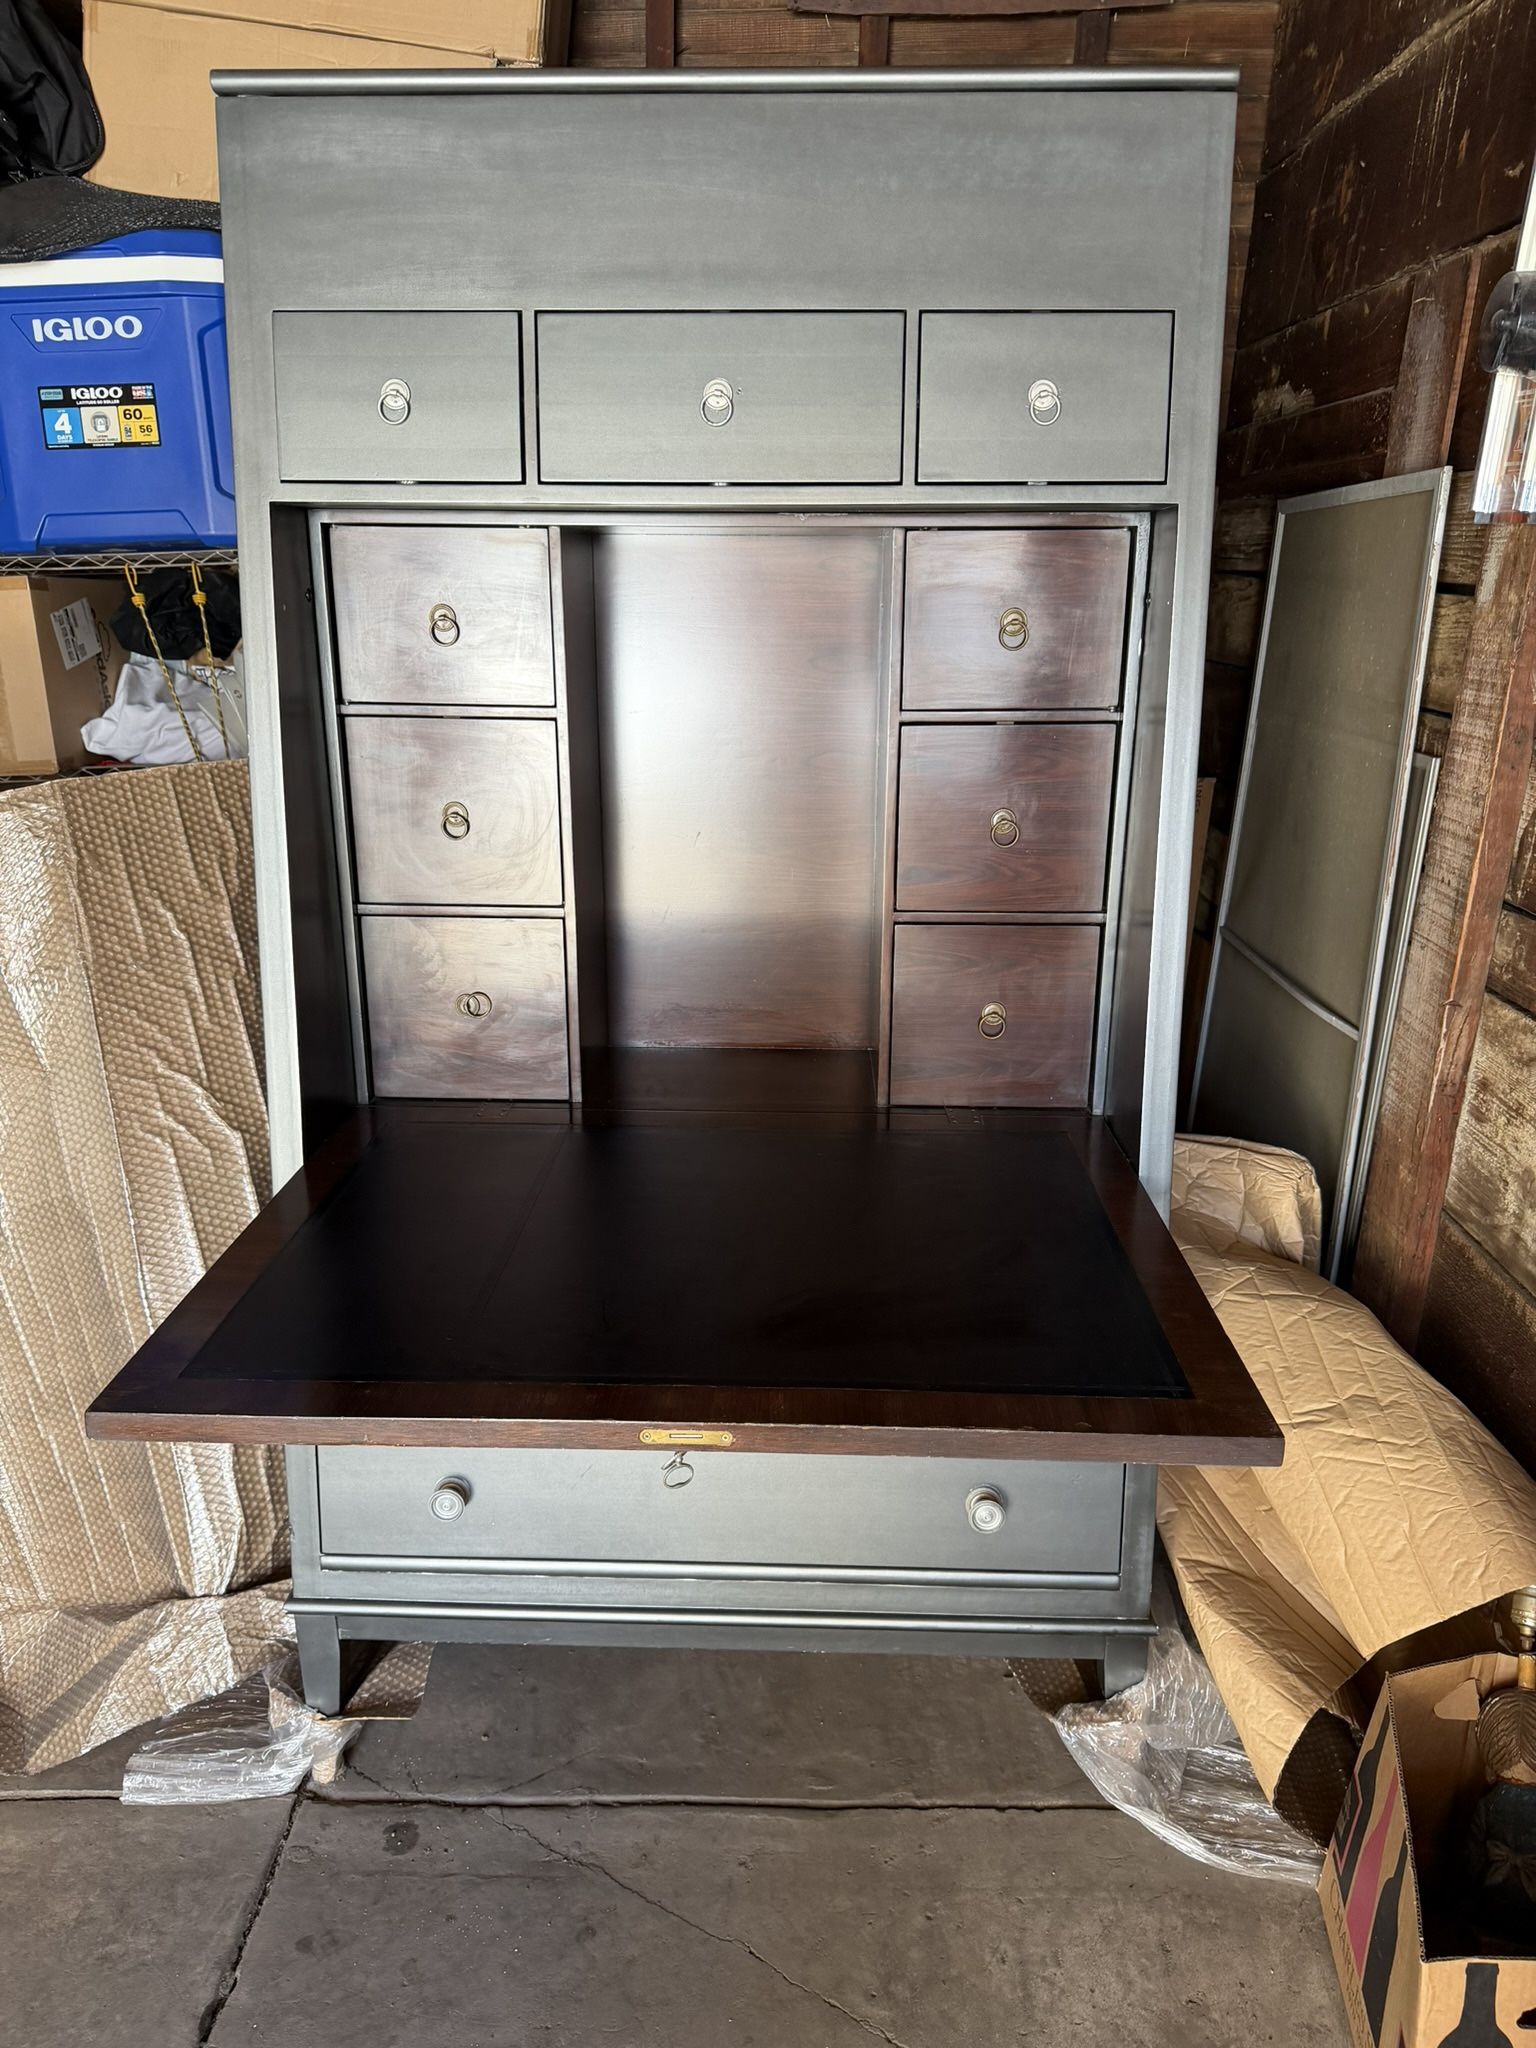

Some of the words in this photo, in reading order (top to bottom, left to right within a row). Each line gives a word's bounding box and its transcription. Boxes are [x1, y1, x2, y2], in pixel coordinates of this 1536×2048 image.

[32, 315, 143, 342] IGLOO
[71, 386, 123, 400] IGLOO
[123, 408, 142, 420] 60
[54, 412, 72, 434] 4
[139, 424, 153, 433] 56
